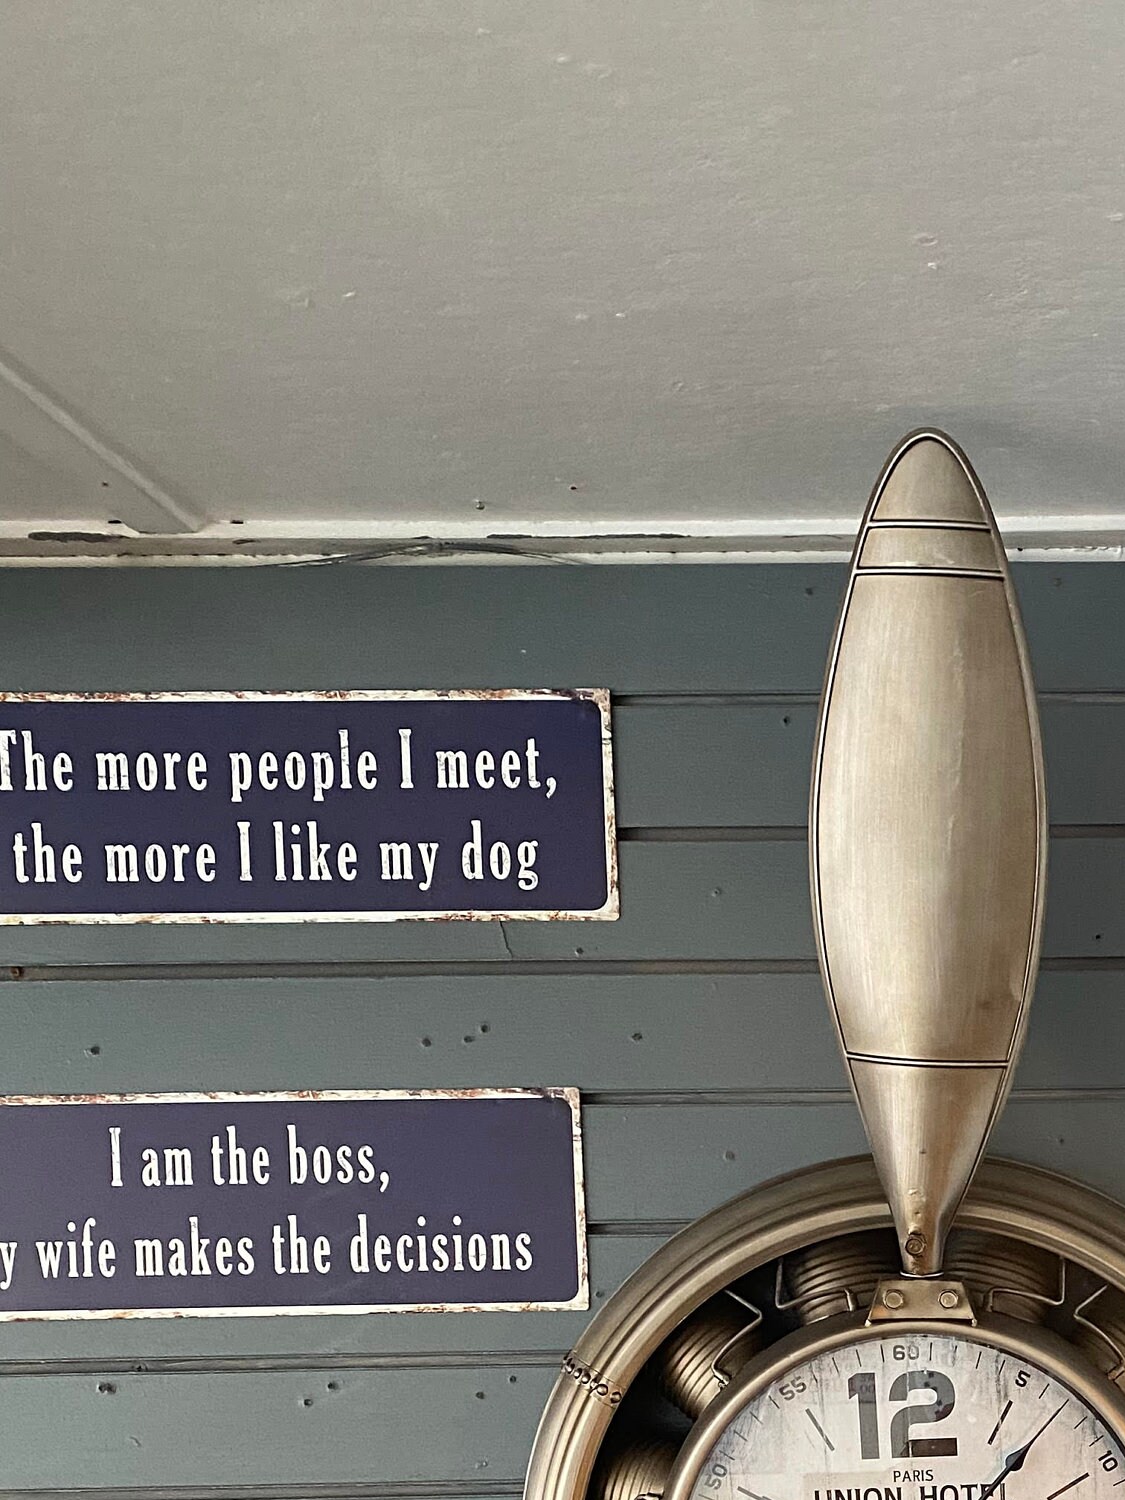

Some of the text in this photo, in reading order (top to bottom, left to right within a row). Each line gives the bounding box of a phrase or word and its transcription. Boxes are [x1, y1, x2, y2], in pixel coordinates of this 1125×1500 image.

[0, 729, 557, 802] The more people I meet,
[13, 820, 539, 890] the more I like my dog
[109, 1125, 390, 1192] I am the boss,
[35, 1217, 116, 1278] wife
[135, 1217, 255, 1276] makes
[272, 1215, 331, 1274] the
[350, 1213, 533, 1272] decisions
[893, 1345, 919, 1360] 60
[779, 1376, 807, 1401] 55
[1015, 1370, 1030, 1388] 5
[848, 1370, 958, 1460] 12
[1098, 1450, 1118, 1472] 10
[707, 1464, 728, 1490] 50
[893, 1470, 934, 1482] PARIS
